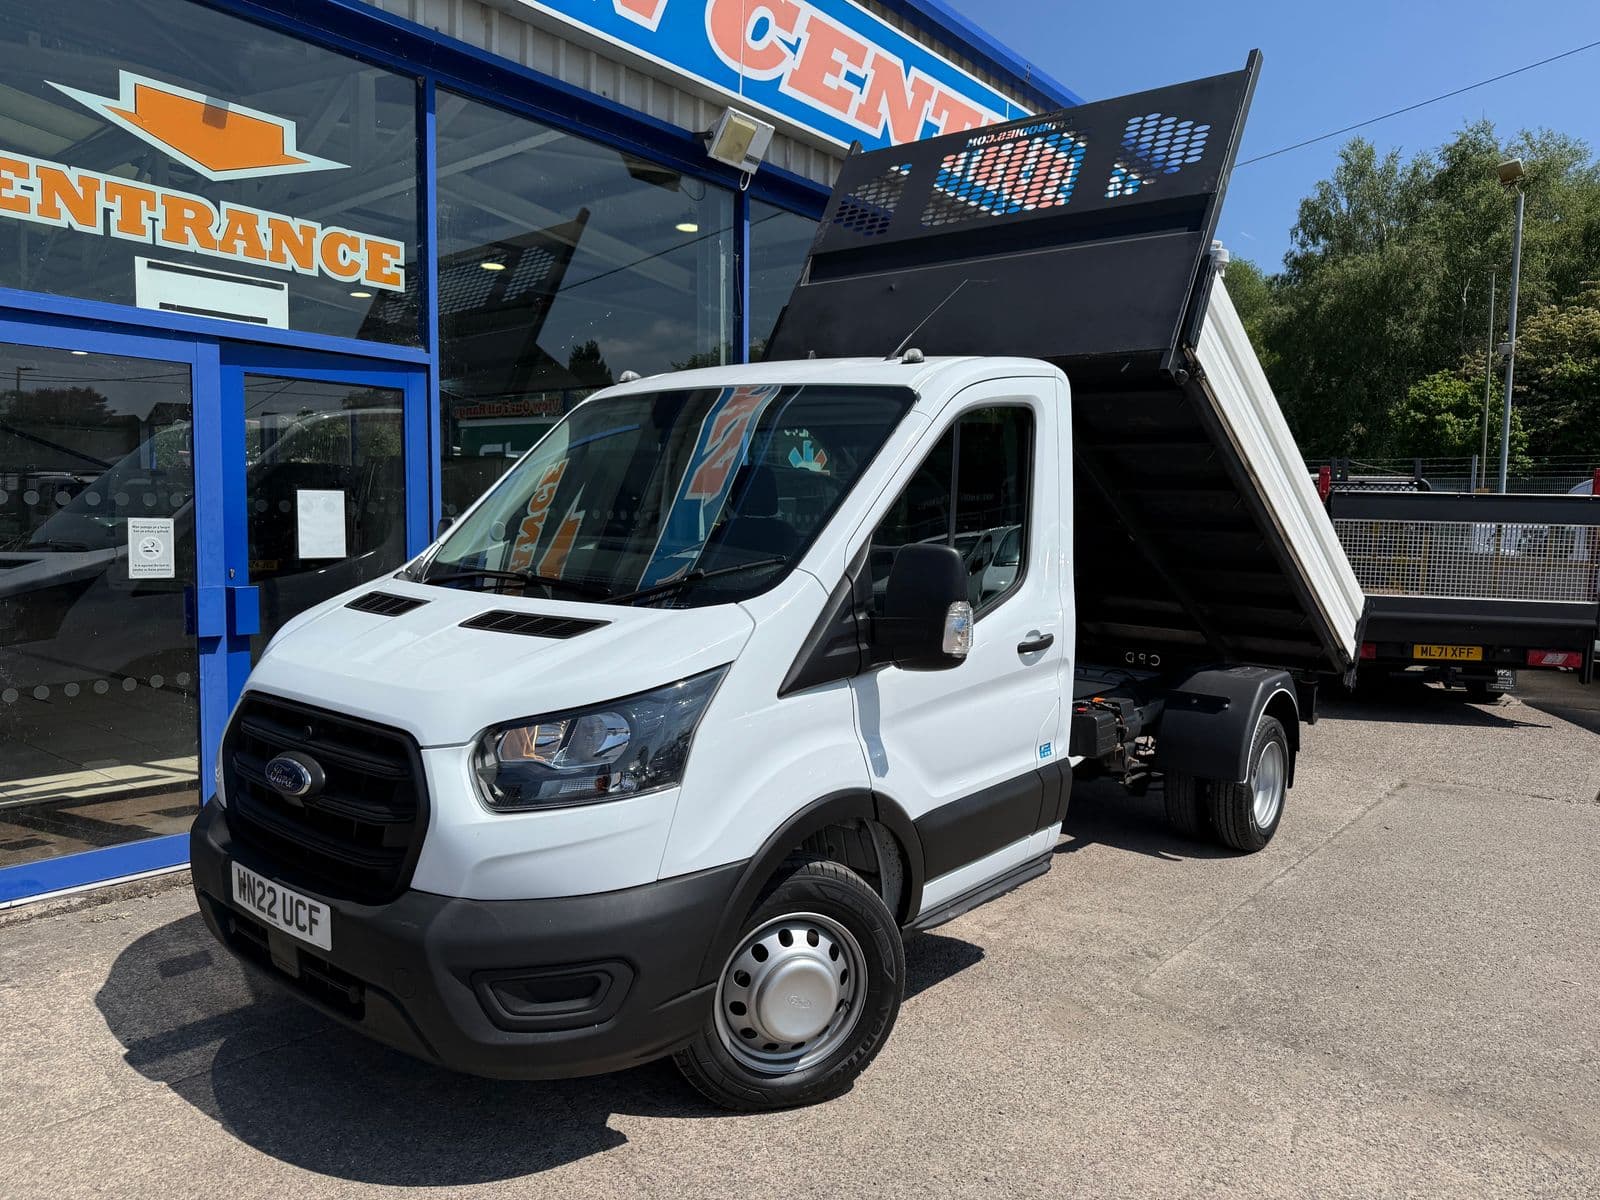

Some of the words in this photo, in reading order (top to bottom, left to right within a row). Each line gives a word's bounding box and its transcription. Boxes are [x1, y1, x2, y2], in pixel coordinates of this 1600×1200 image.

[704, 0, 1005, 145] CENT
[0, 152, 404, 291] ENTRANCE
[269, 764, 298, 788] Ford
[237, 868, 278, 920] WN22
[282, 892, 321, 936] UCF
